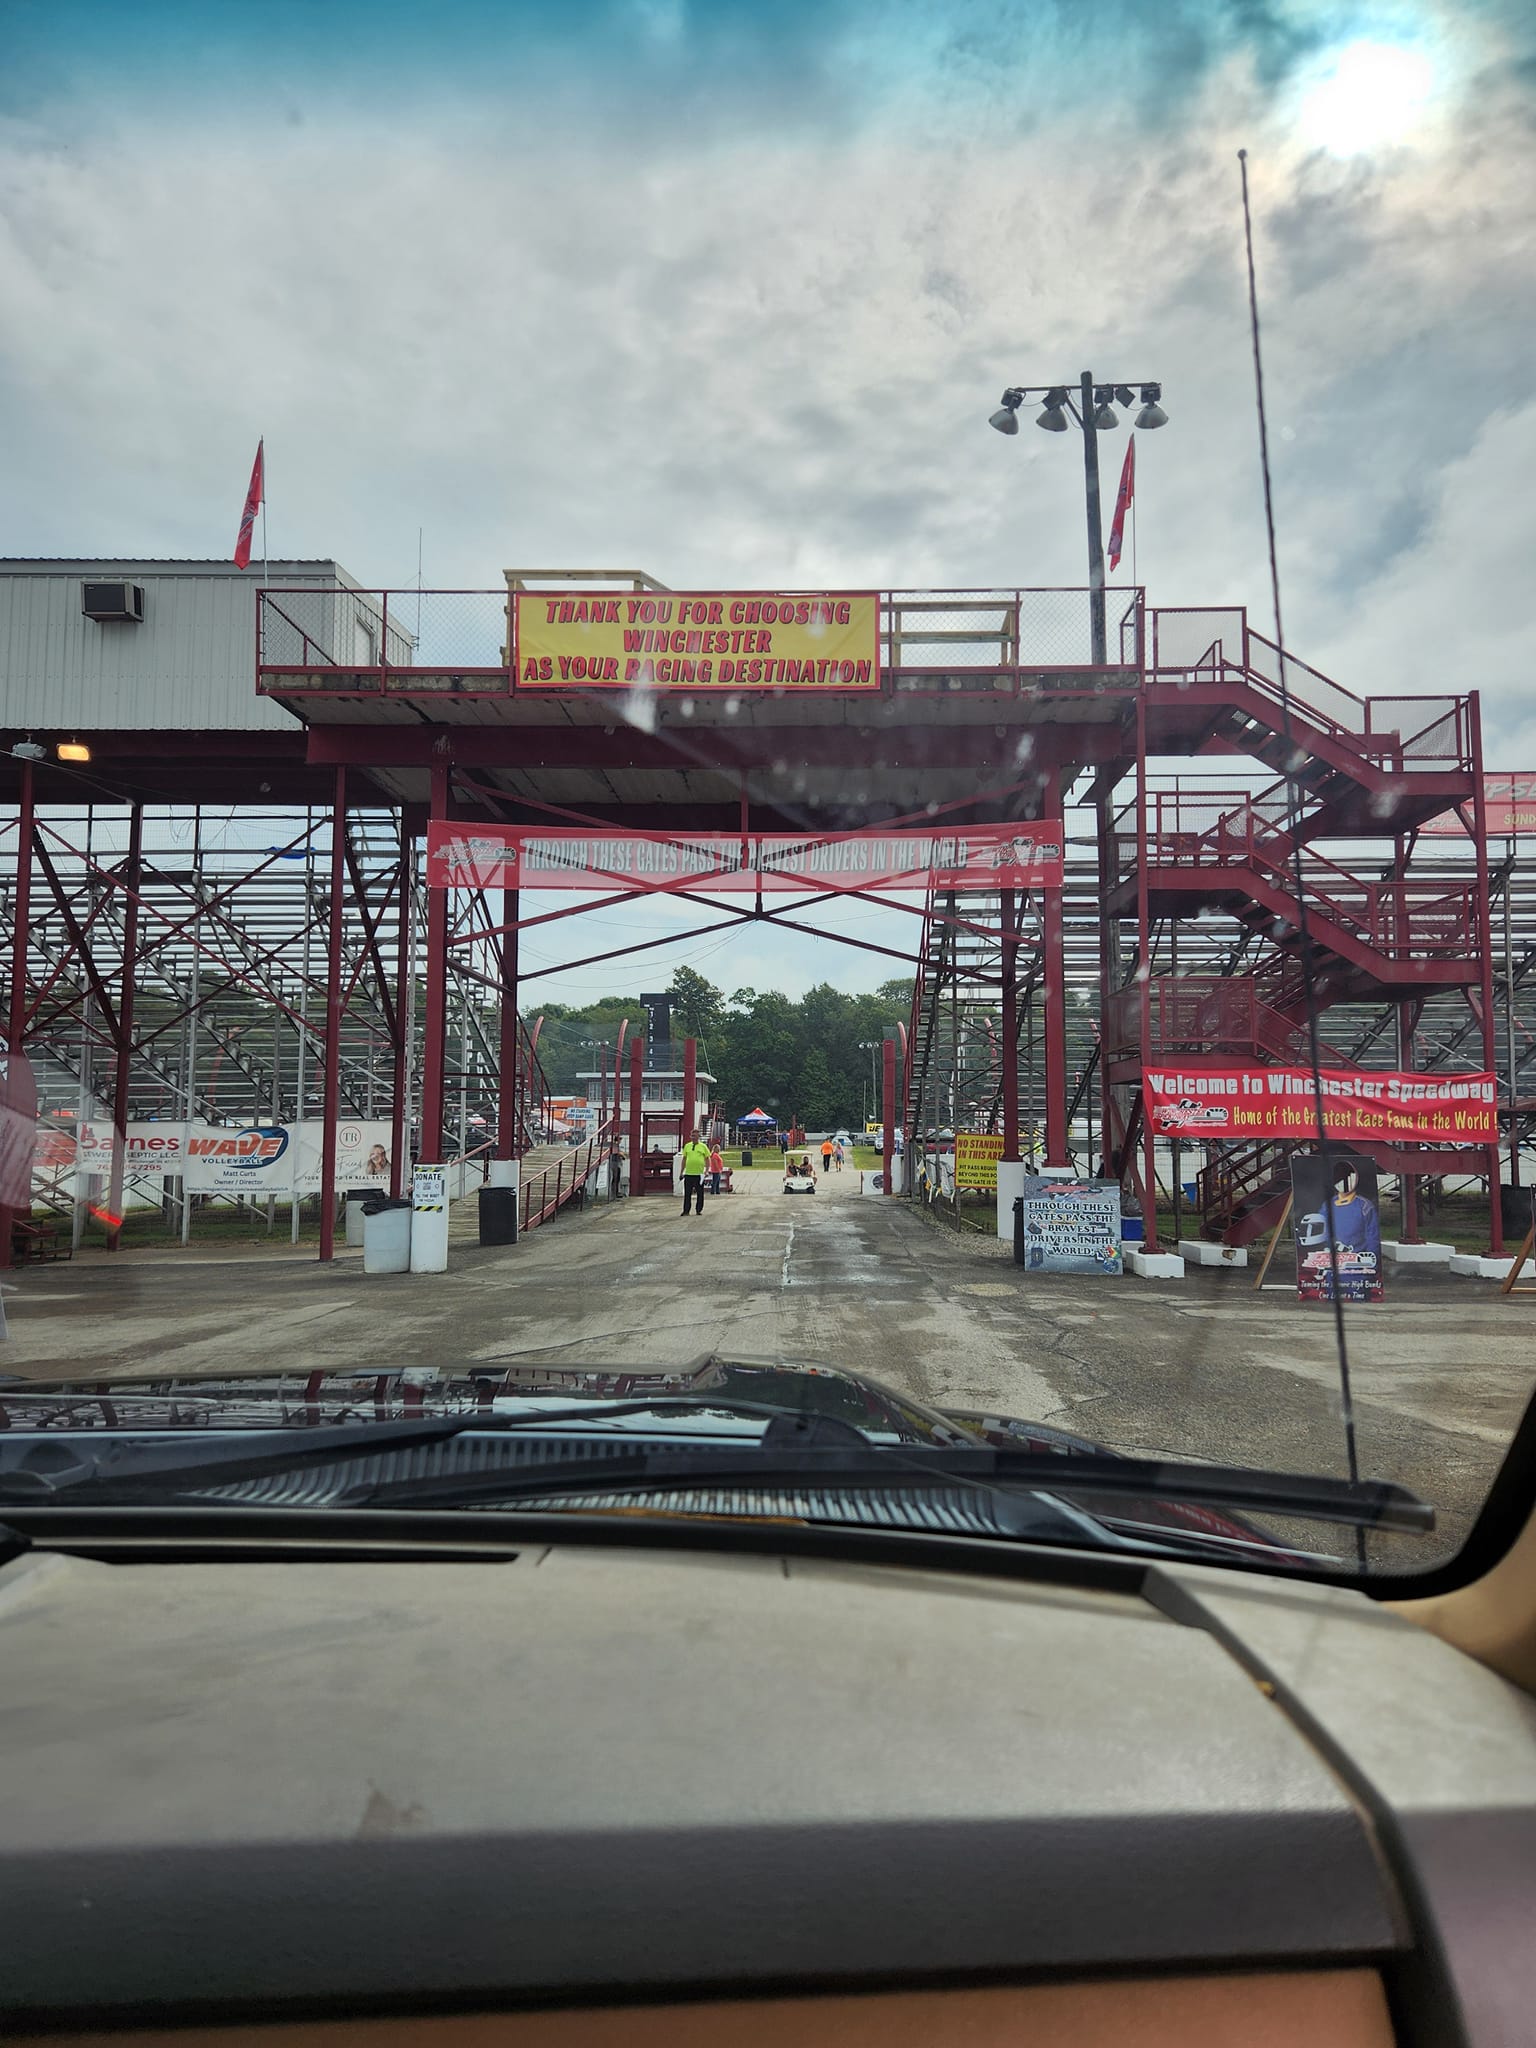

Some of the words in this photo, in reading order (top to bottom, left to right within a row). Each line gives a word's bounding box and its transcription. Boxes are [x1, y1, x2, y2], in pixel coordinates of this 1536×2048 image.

[546, 600, 621, 623] THANK
[627, 600, 672, 624] YOU
[678, 601, 723, 625] FOR
[729, 601, 851, 625] CHOOSING
[623, 629, 772, 653] WINCHESTER
[523, 657, 552, 680] AS
[558, 656, 619, 681] YOUR
[624, 658, 712, 683] RACING
[718, 659, 872, 683] DESTINATION
[524, 839, 589, 871] THROUGH
[591, 841, 633, 872] THESE
[636, 842, 678, 873] GATES
[681, 842, 715, 873] PASS
[718, 842, 744, 873] THE
[747, 840, 808, 873] BRAVEST
[811, 841, 868, 873] DRIVERS
[871, 841, 887, 871] IN
[890, 841, 915, 870] THE
[919, 839, 969, 870] WORLD
[1148, 1074, 1239, 1095] Welcome
[1242, 1074, 1264, 1095] to
[1267, 1074, 1385, 1098] Winchester
[1387, 1079, 1494, 1103] Speedway
[1233, 1106, 1263, 1126] Home
[1266, 1106, 1278, 1125] of
[1281, 1107, 1302, 1126] the
[1304, 1107, 1351, 1127] Gratest
[1355, 1108, 1384, 1128] Race
[1387, 1110, 1413, 1130] Fans
[1417, 1111, 1428, 1129] in
[1432, 1111, 1450, 1130] the
[1454, 1110, 1490, 1130] World
[1494, 1111, 1499, 1130] !
[187, 1134, 283, 1155] WAVE
[342, 1132, 358, 1142] TR
[957, 1139, 969, 1148] NO
[970, 1139, 1004, 1150] STANDIN
[958, 1150, 967, 1158] IN
[969, 1150, 986, 1159] THIS
[987, 1151, 1002, 1160] ARE
[1027, 1202, 1080, 1210] THROUGH
[1083, 1203, 1117, 1211] THESE
[1066, 1213, 1093, 1221] PASS
[1094, 1214, 1116, 1222] THE
[1048, 1224, 1097, 1233] BRAVEST
[1030, 1235, 1077, 1243] DRIVERS
[1078, 1236, 1092, 1244] IN
[1094, 1236, 1116, 1245] THE
